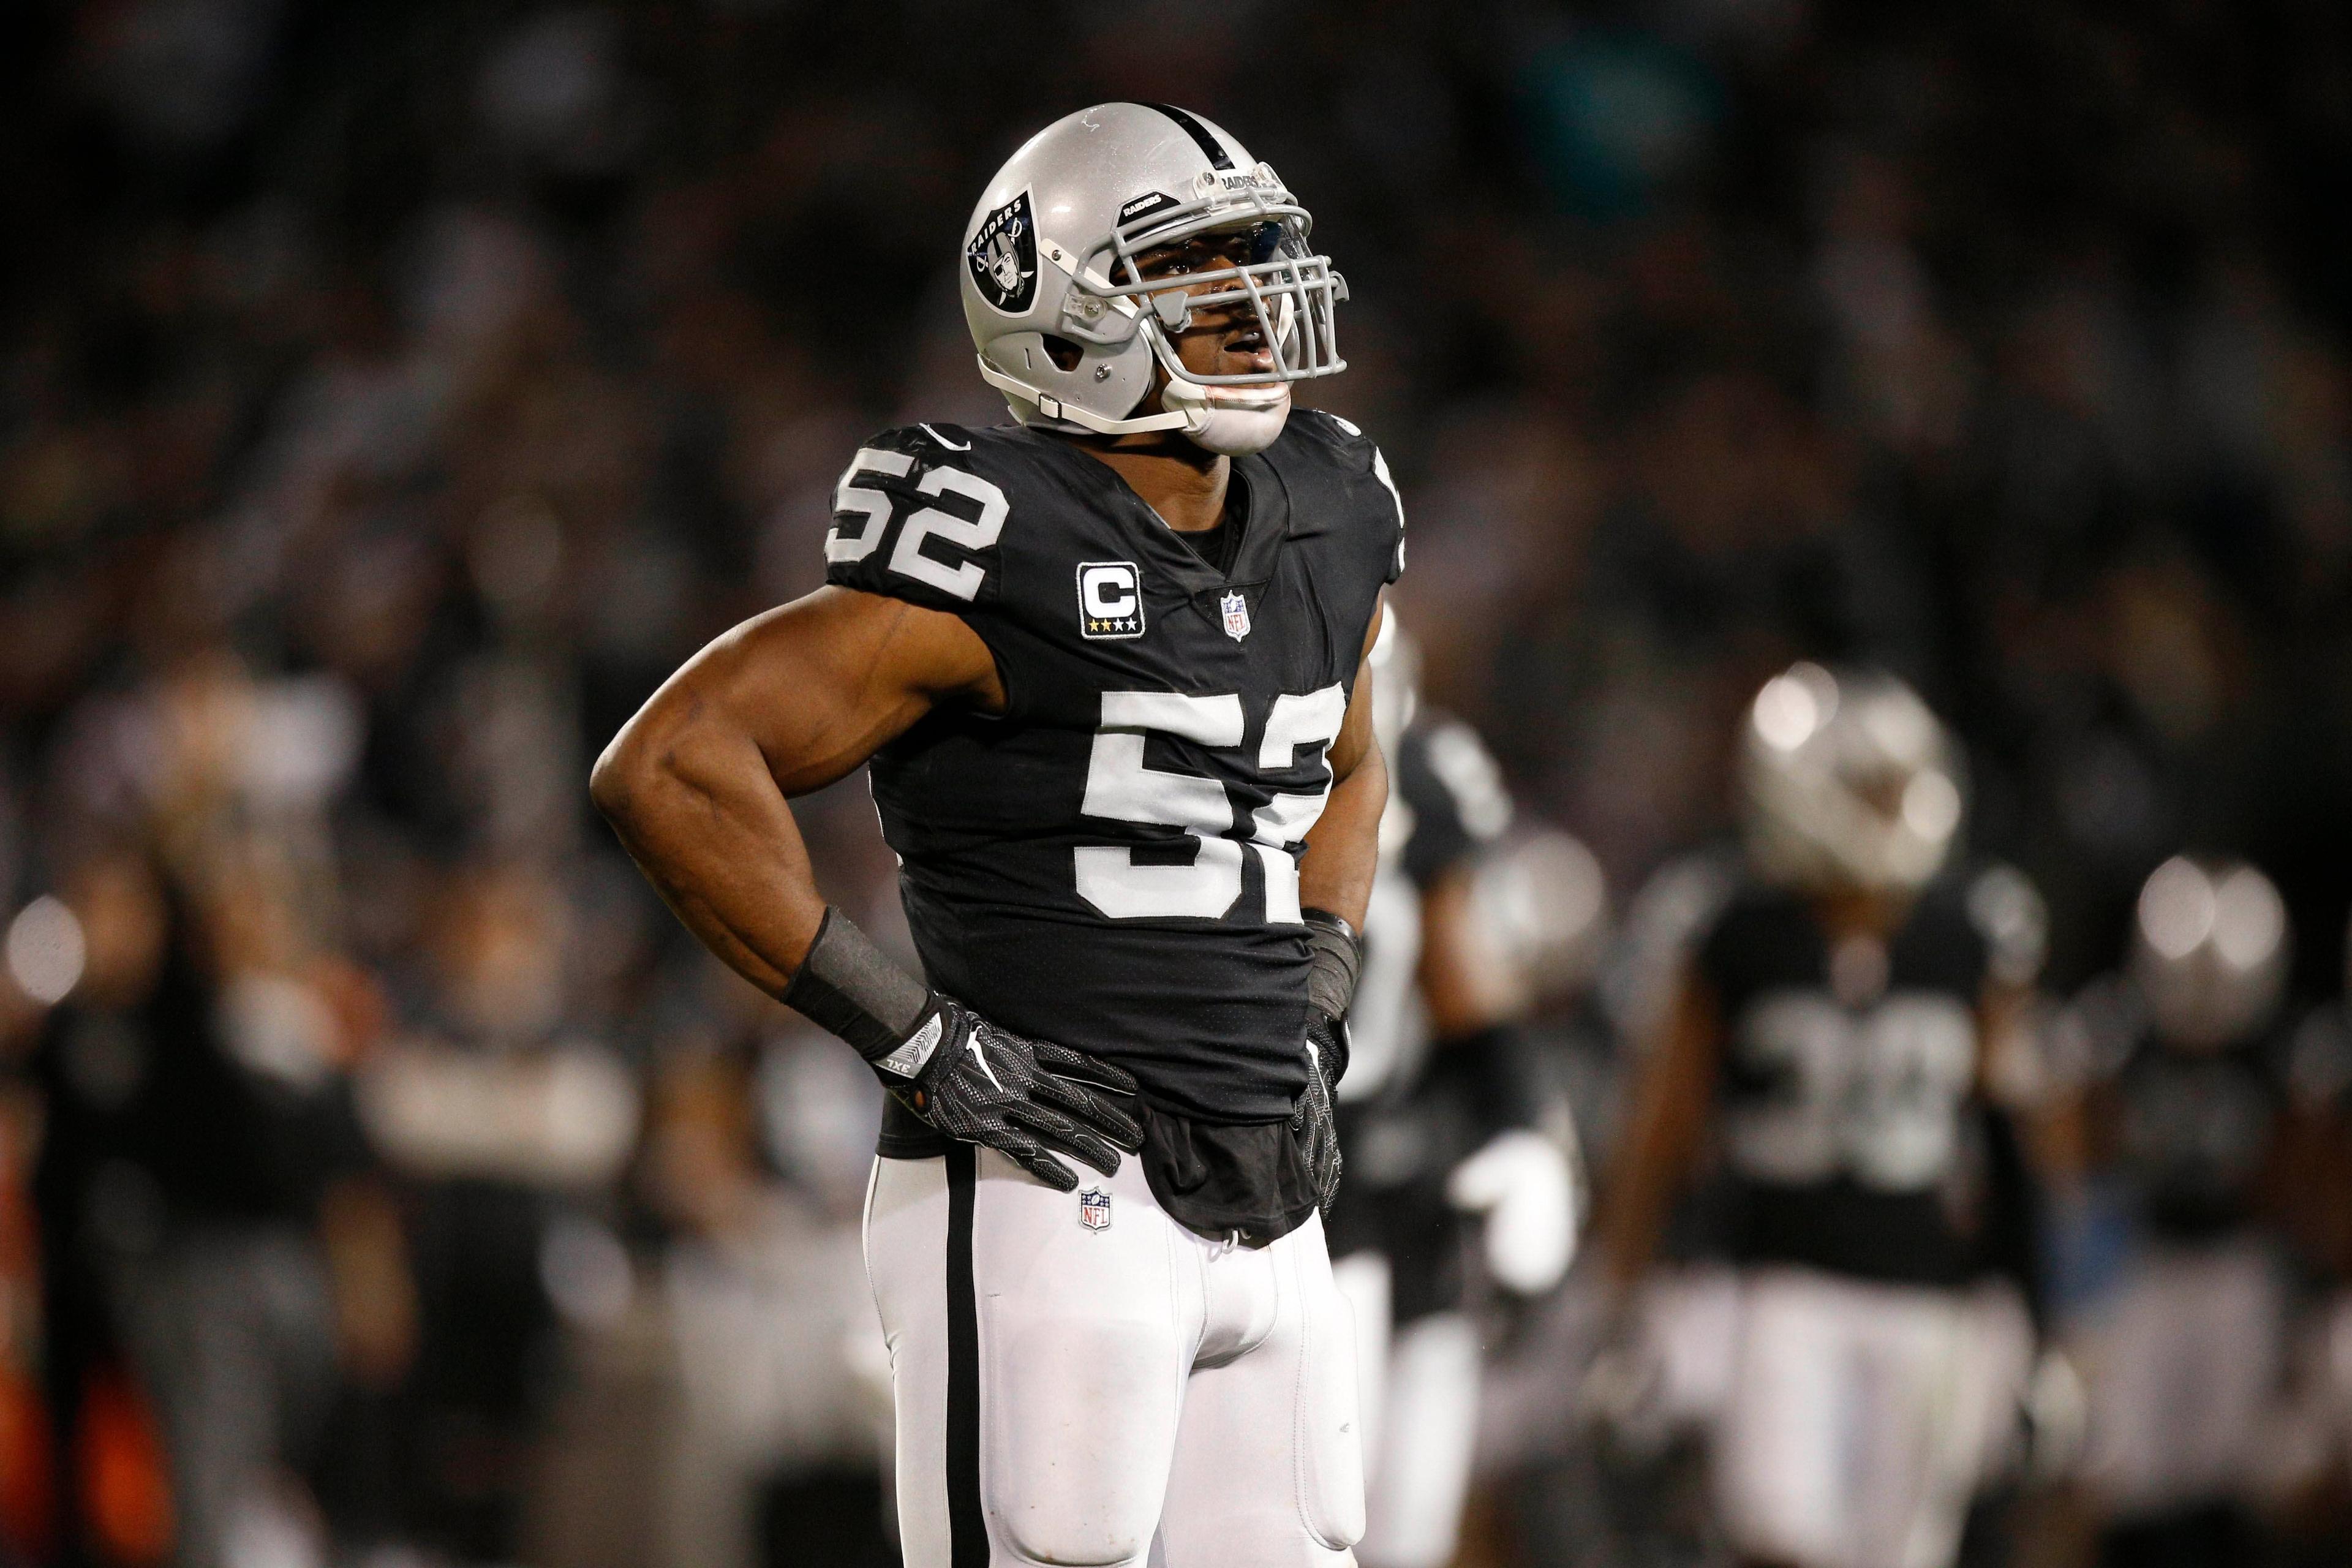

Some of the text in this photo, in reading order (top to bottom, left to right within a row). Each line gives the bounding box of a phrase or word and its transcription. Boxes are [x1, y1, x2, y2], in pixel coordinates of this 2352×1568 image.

[1123, 194, 1162, 217] RAIDERS
[971, 199, 1022, 255] RAIDERS
[824, 448, 1010, 602] 52
[1083, 567, 1136, 619] C
[1227, 614, 1245, 632] NFL
[1074, 680, 1346, 925] 52
[886, 1058, 911, 1073] 3XL
[1084, 1207, 1107, 1226] NFL
